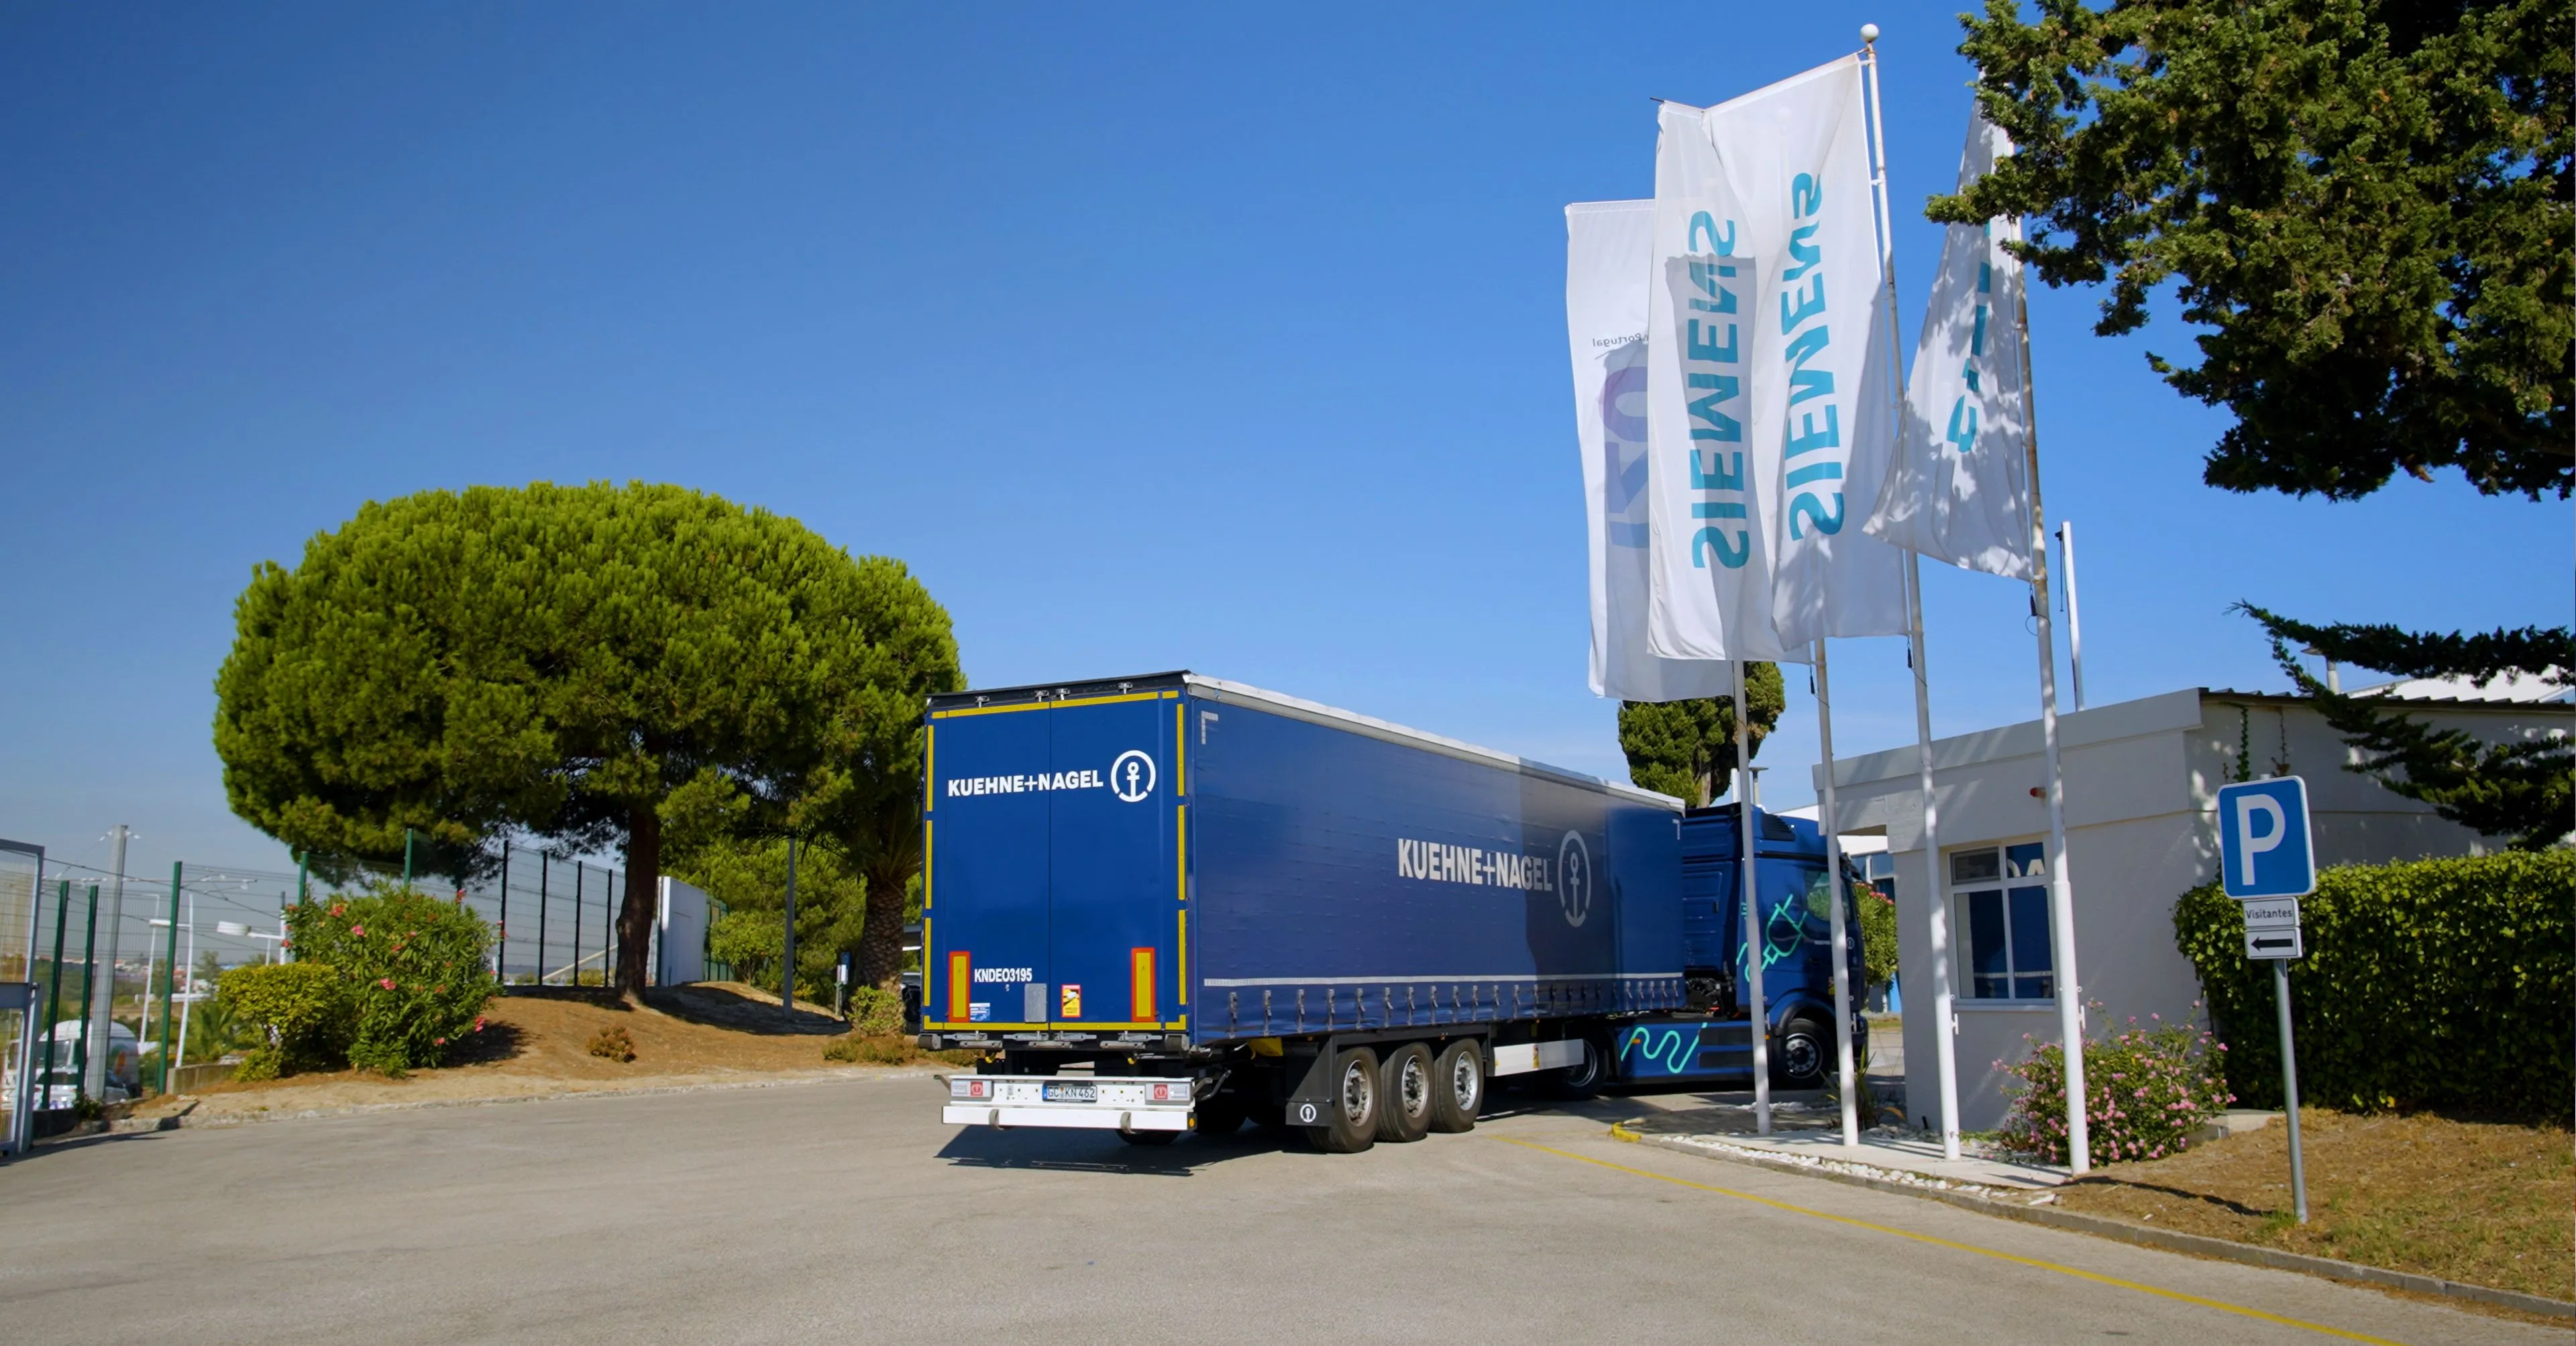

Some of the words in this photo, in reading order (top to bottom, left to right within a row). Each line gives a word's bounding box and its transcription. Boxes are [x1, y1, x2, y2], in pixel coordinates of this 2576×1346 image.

[948, 770, 1104, 797] KUEHNE+NAGEL
[2236, 794, 2286, 886] P
[1397, 837, 1553, 892] KUEHNE+NAGEL
[2245, 909, 2293, 920] Visitantes
[1065, 1087, 1077, 1098] KN
[1078, 1088, 1095, 1098] 462
